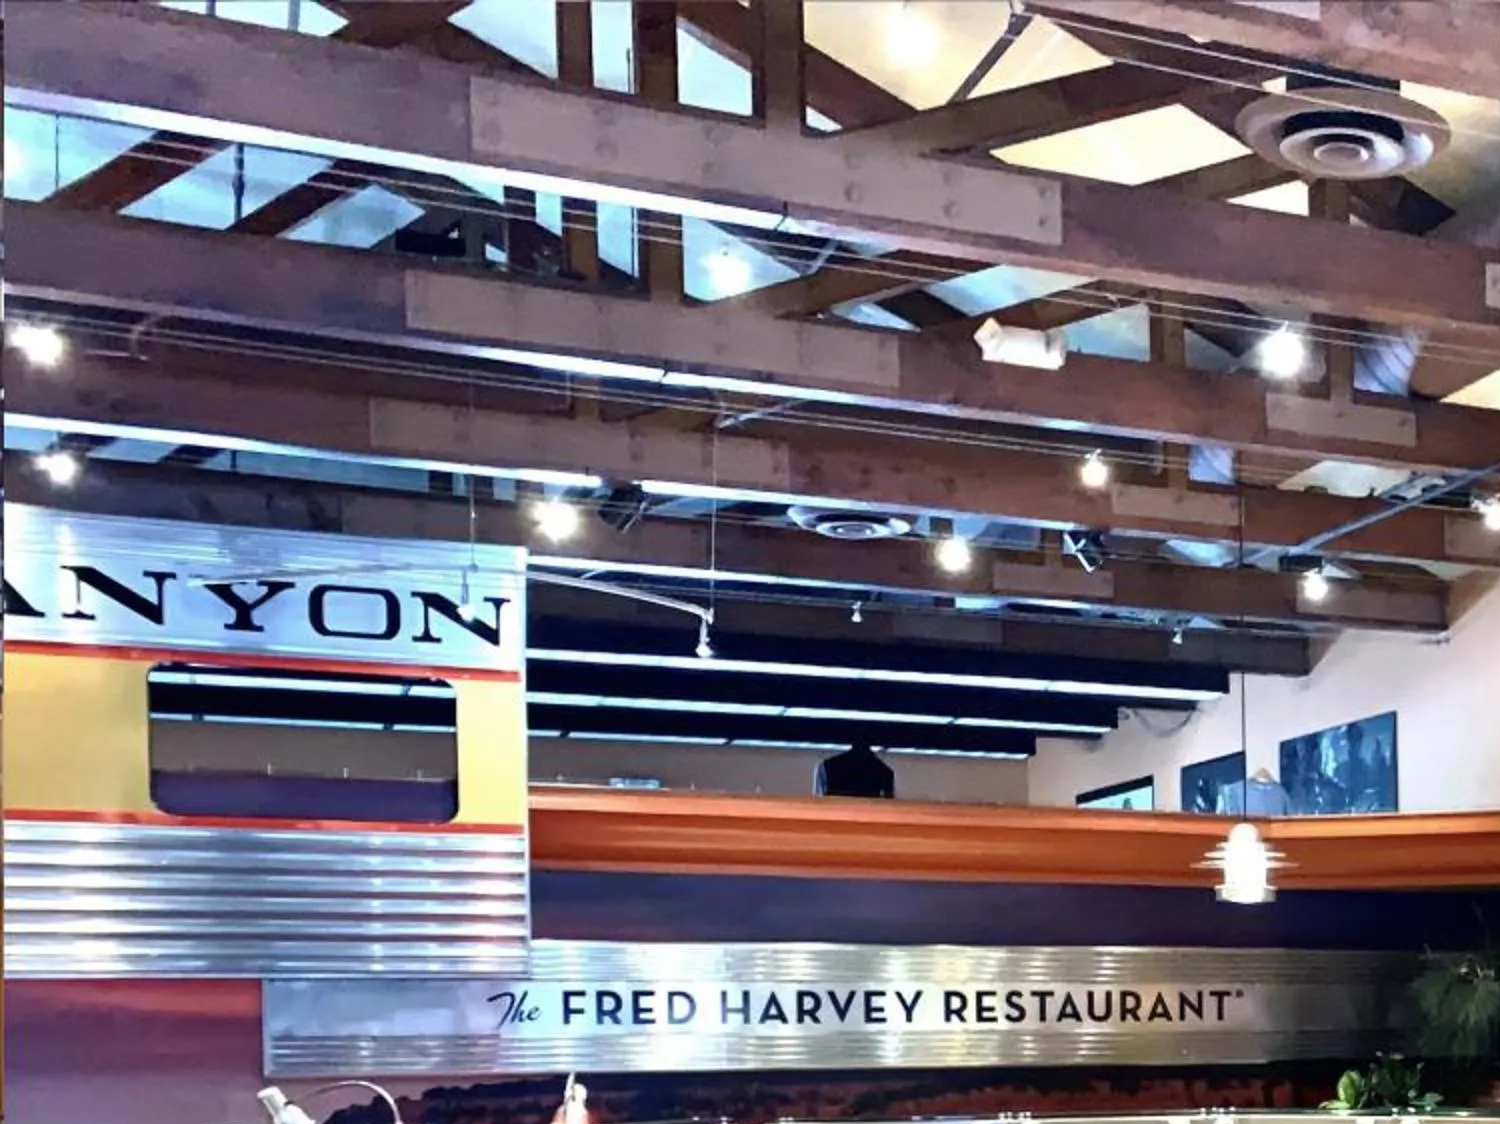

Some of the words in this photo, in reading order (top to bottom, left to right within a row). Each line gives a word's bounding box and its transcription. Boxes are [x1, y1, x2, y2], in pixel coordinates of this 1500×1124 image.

[486, 991, 541, 1029] The
[562, 990, 697, 1025] FRED
[720, 989, 924, 1025] HARVEY
[944, 989, 1232, 1022] RESTAURANT
